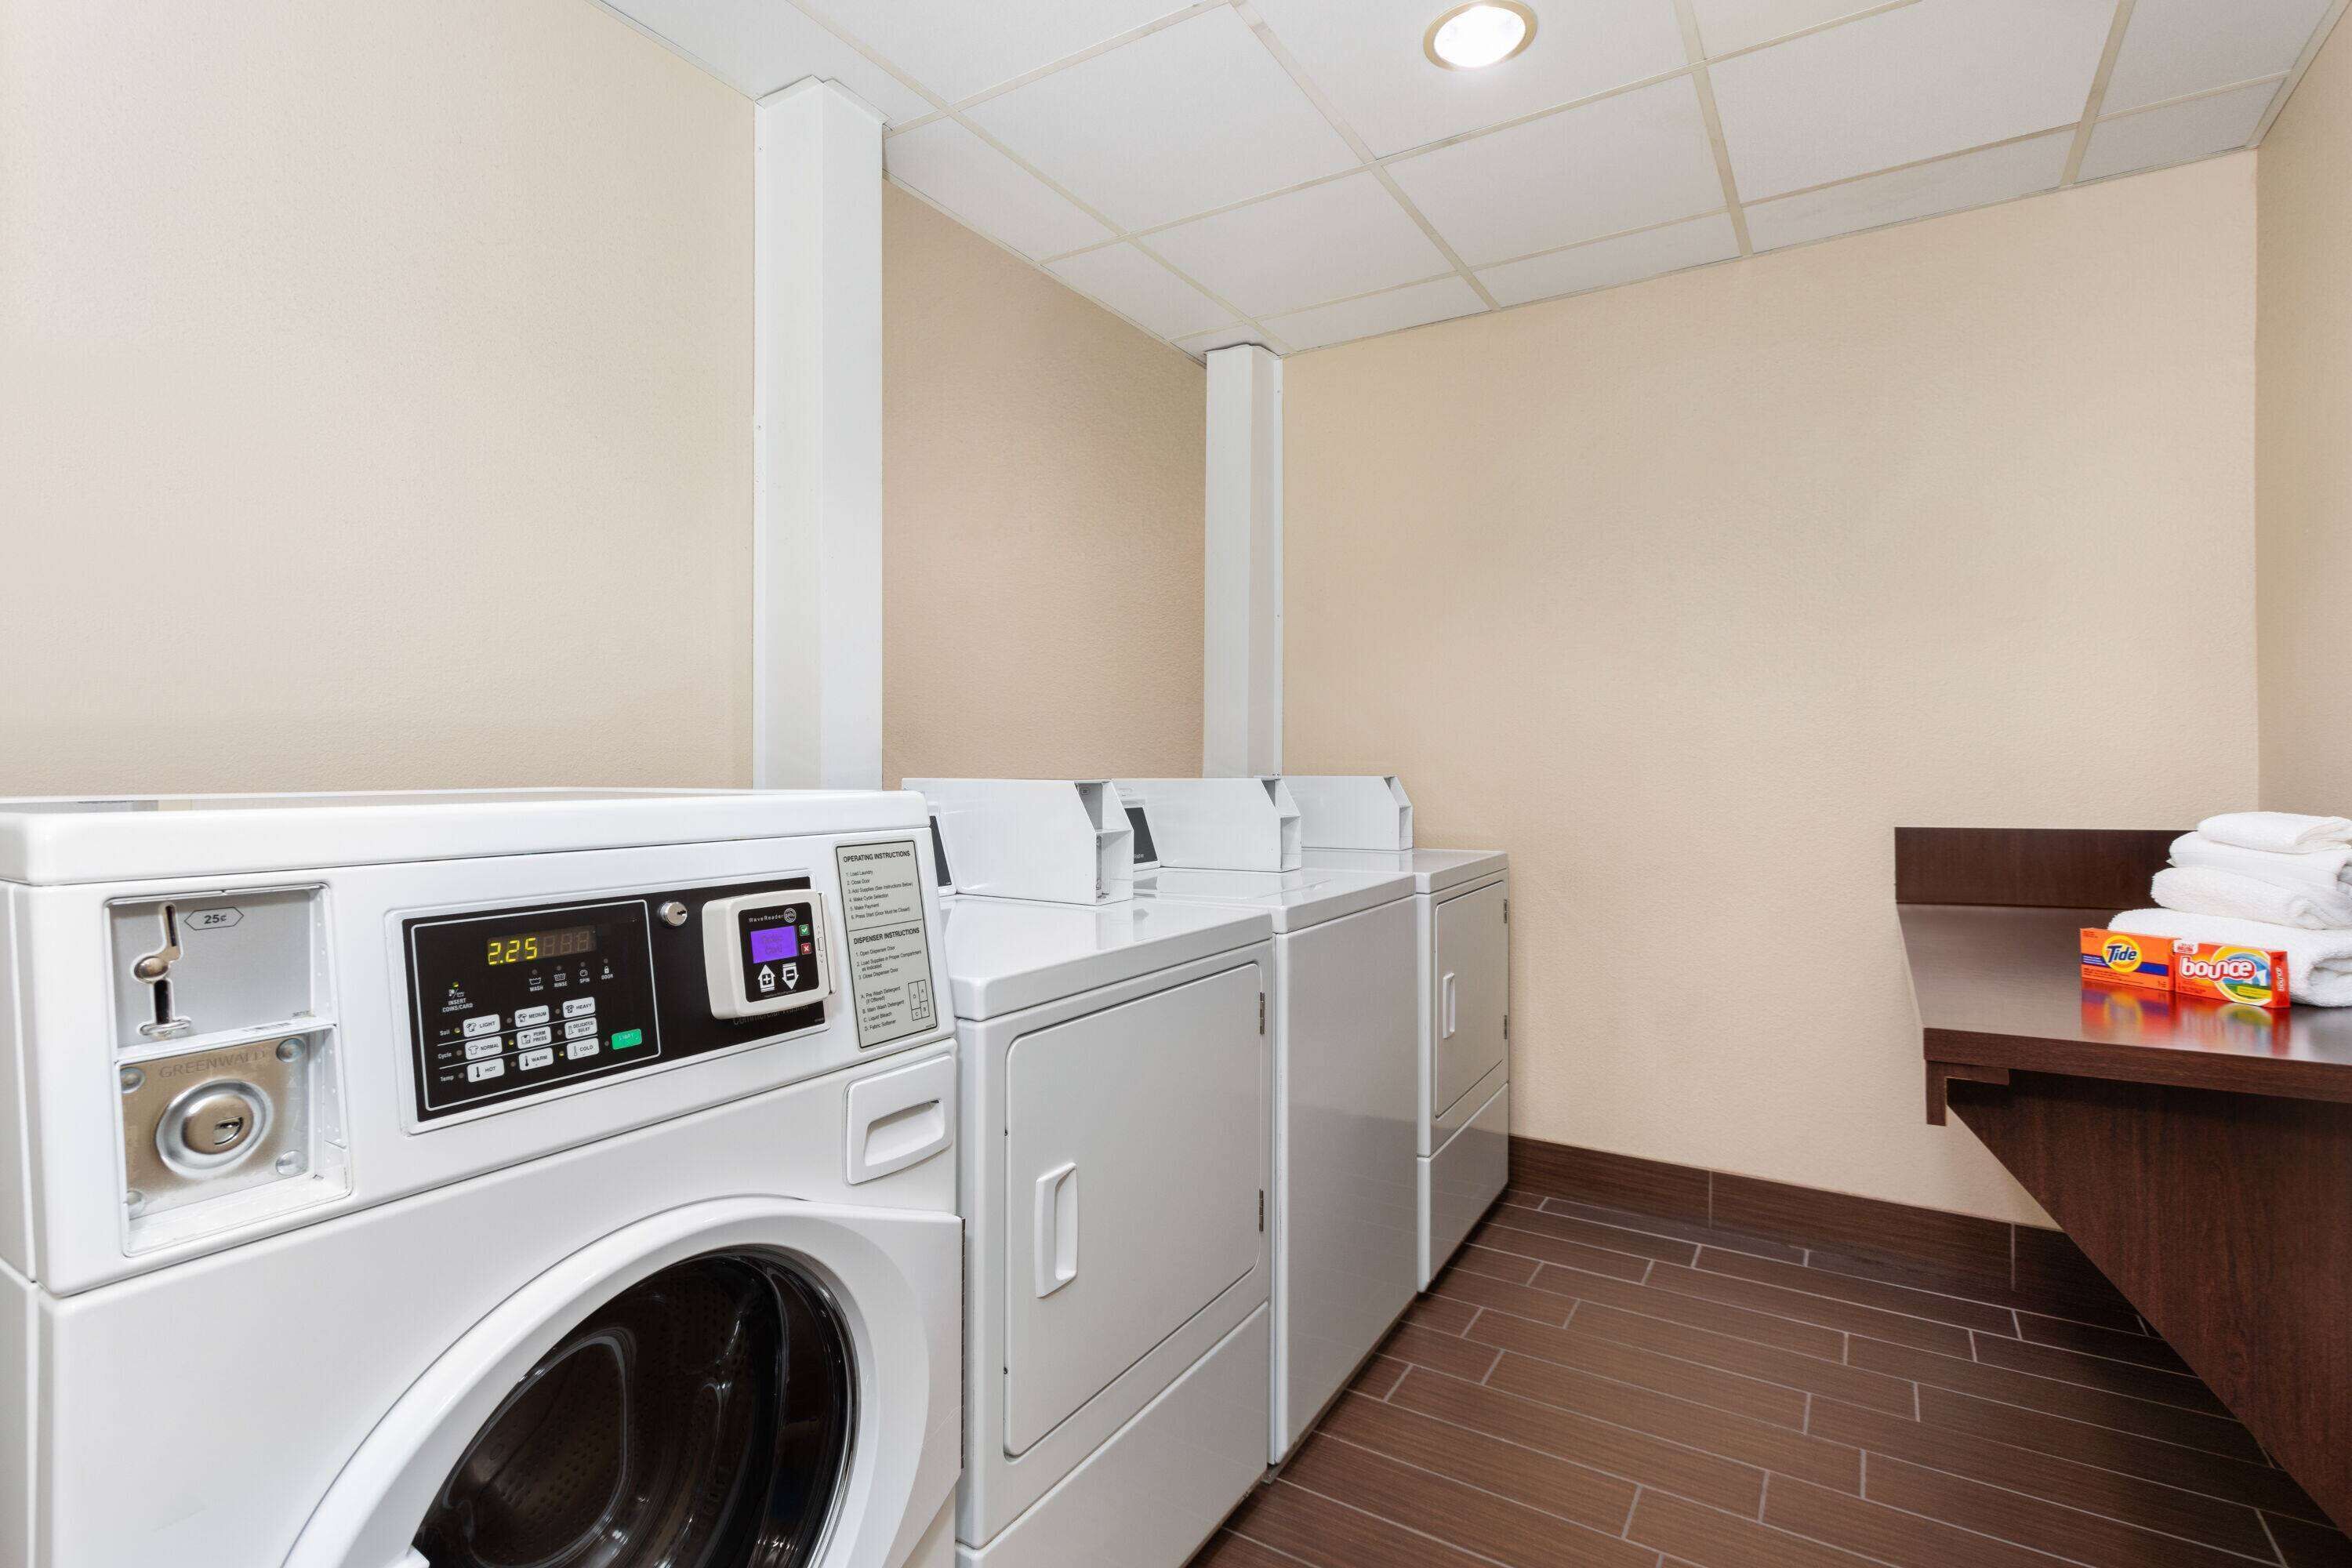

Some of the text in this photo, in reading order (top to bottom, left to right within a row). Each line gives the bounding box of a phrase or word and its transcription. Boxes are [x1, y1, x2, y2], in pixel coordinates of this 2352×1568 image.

[843, 851, 910, 863] OPERATING INSTRUCTIONS
[854, 927, 920, 944] DISPENSER INSTRUCTIONS
[488, 938, 538, 965] 2.25
[2107, 945, 2137, 964] Tide
[2181, 956, 2255, 980] bounce
[448, 997, 466, 1006] INSERT
[887, 1000, 904, 1009] Detergent
[442, 1003, 474, 1013] COINS/CARD
[619, 1033, 634, 1041] START
[532, 1054, 548, 1062] WARM
